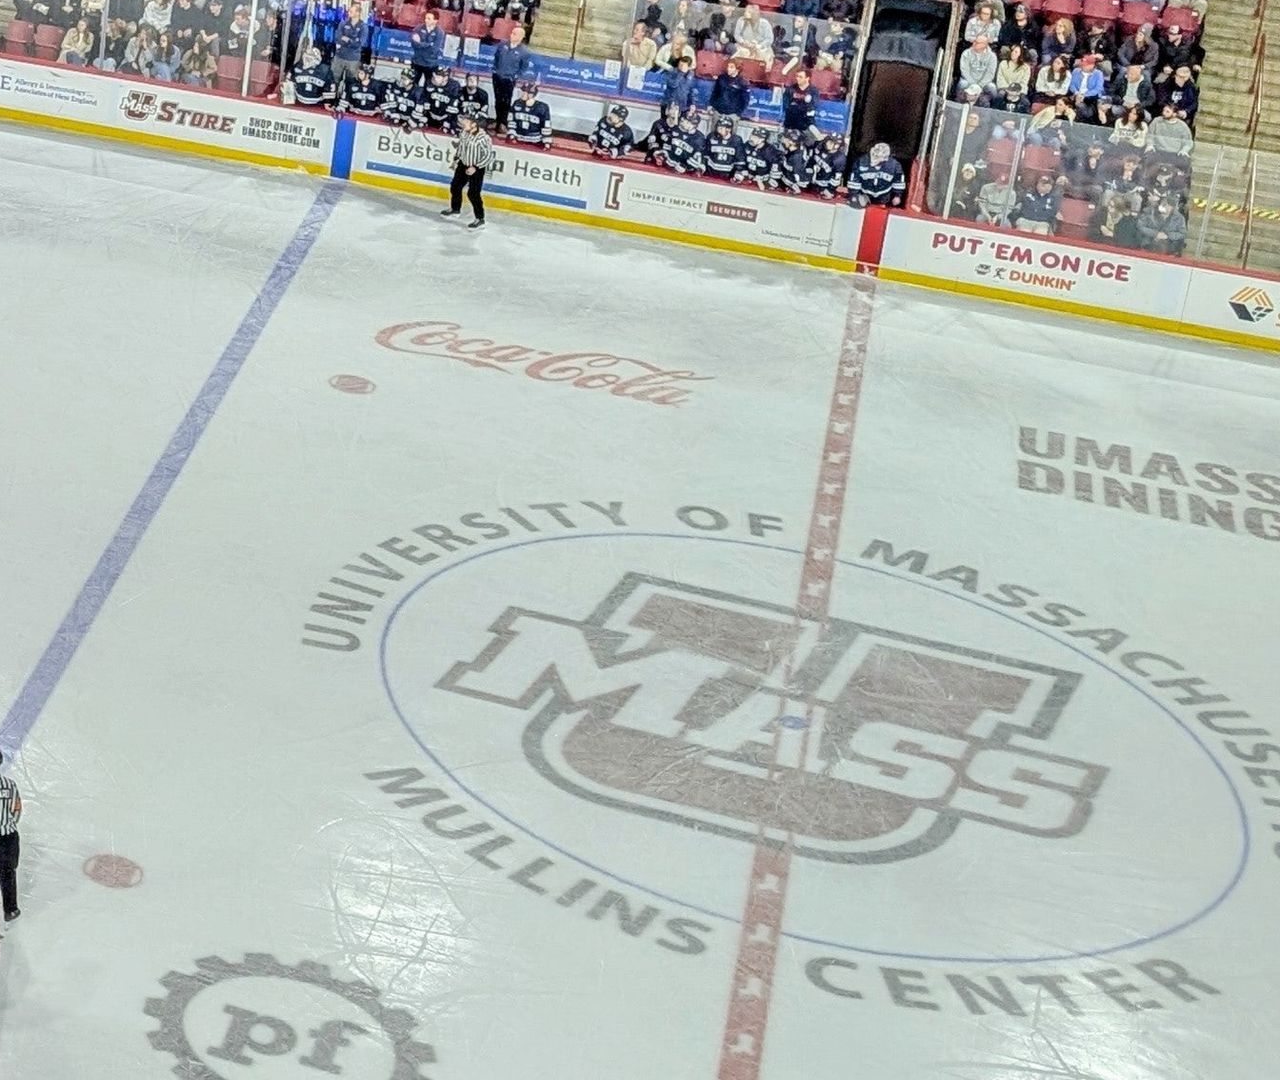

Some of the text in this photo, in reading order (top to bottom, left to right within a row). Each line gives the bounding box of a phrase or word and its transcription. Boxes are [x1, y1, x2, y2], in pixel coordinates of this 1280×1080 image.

[71, 96, 97, 106] England
[242, 126, 320, 148] UMASSSTORE.COM
[249, 117, 315, 137] SHOP ONLINE AT
[378, 136, 581, 187] Baystat Health
[630, 191, 755, 219] INSPIRE IMPACT ISENBERG
[932, 232, 1132, 282] PUT 'EM ON ICE
[1008, 270, 1077, 292] DUNKIN'
[374, 321, 714, 408] Coca-Cola
[1018, 426, 1280, 505] UMASS
[1018, 459, 1280, 541] DINING
[302, 499, 790, 651] UNIVERSITY OF
[364, 765, 1222, 1017] MULLINS CENTER
